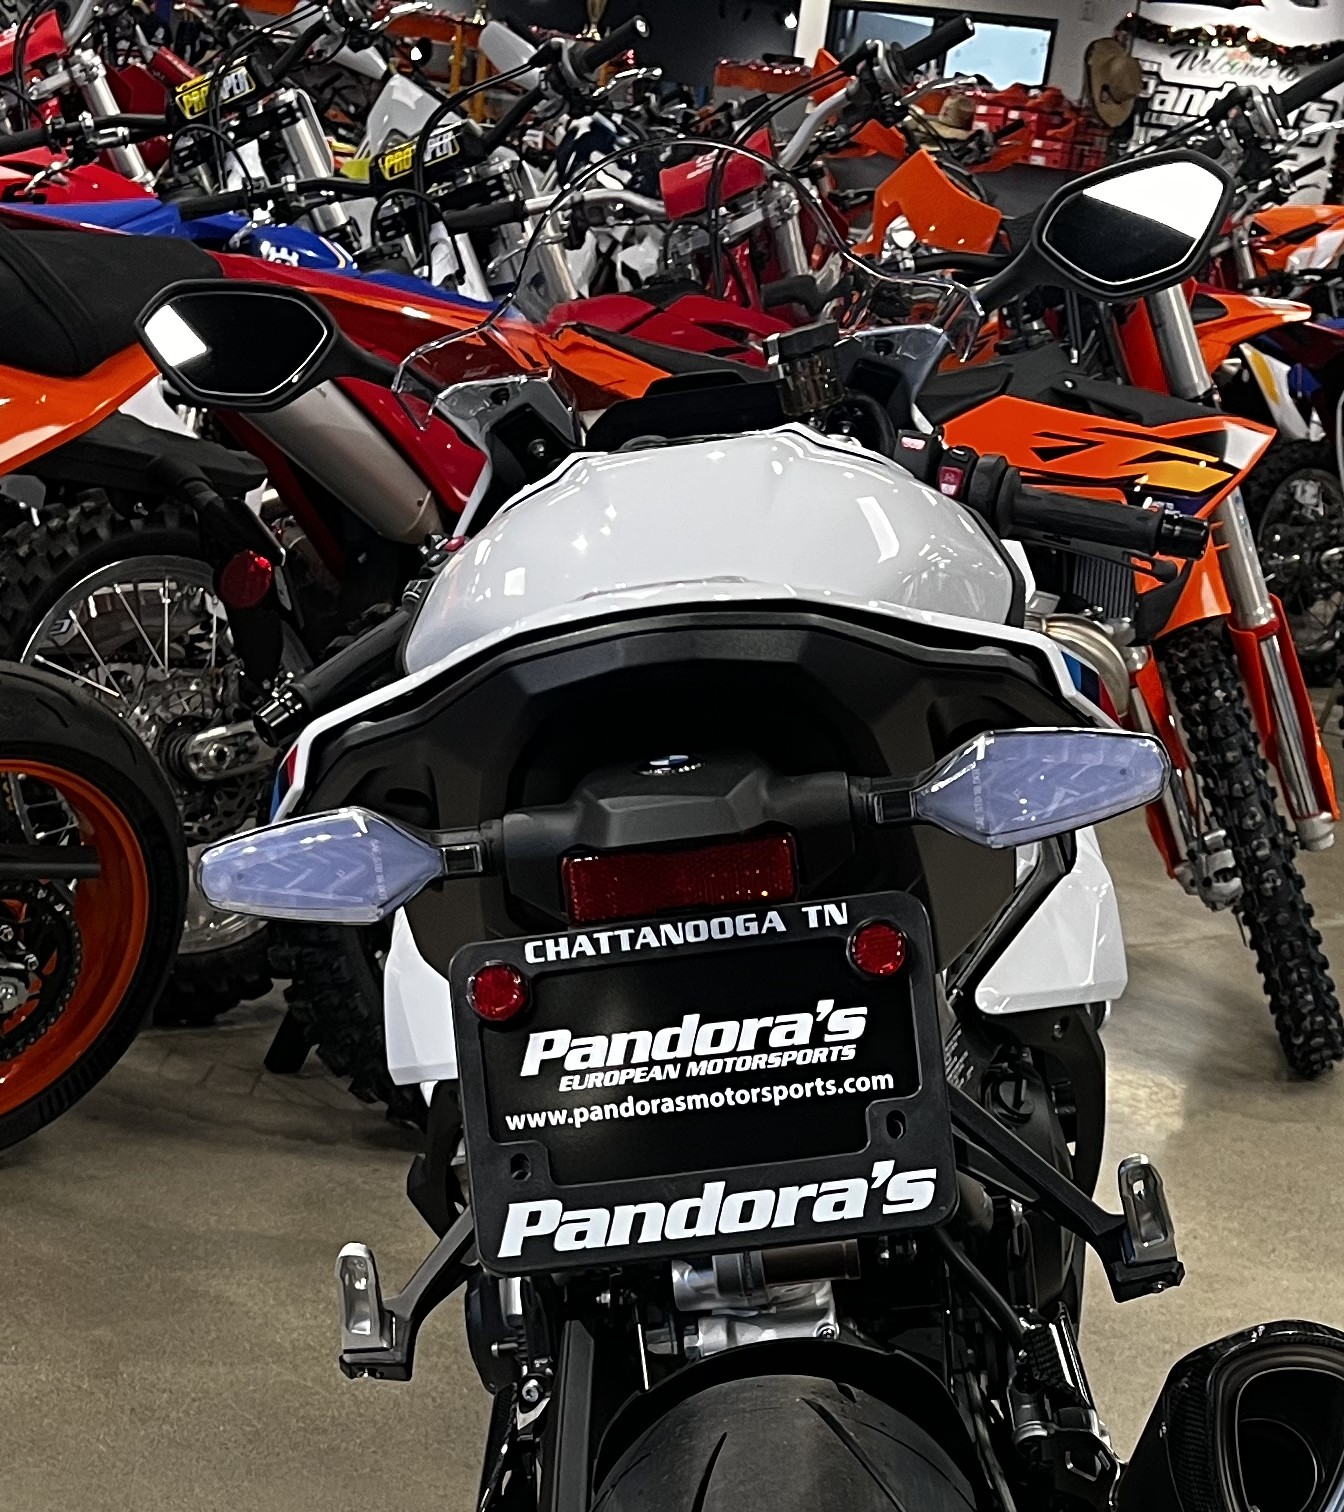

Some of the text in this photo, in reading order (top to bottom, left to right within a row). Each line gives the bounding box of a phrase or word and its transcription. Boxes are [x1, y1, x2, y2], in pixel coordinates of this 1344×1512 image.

[384, 147, 413, 179] PRO
[524, 902, 848, 964] CHATTANOOGA TN
[519, 998, 868, 1078] Pandora's
[559, 1045, 857, 1092] EUROPEAN MOTORSPORTS
[505, 1073, 895, 1131] www.pandorasmotorsports.com
[497, 1159, 937, 1258] Pandora's
